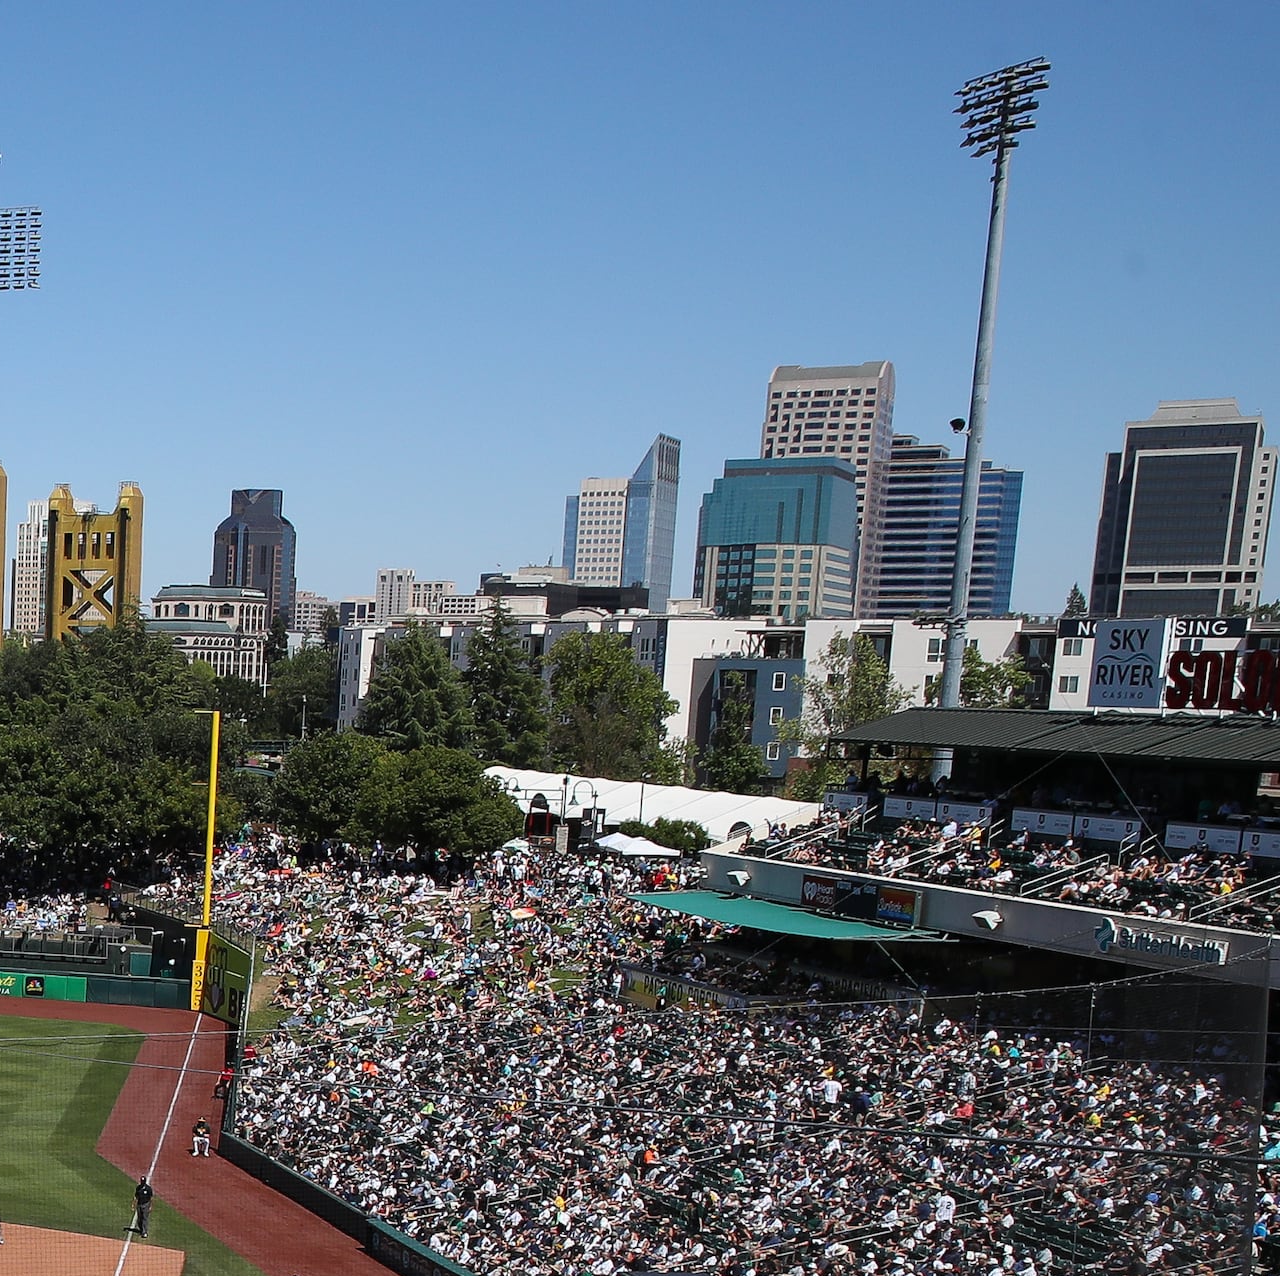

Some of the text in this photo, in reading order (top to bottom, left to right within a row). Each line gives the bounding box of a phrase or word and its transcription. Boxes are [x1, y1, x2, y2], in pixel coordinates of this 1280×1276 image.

[1109, 628, 1150, 652] SKY
[1095, 664, 1154, 689] RIVER
[1102, 690, 1144, 700] CASINO
[1119, 927, 1230, 966] Sutter Health
